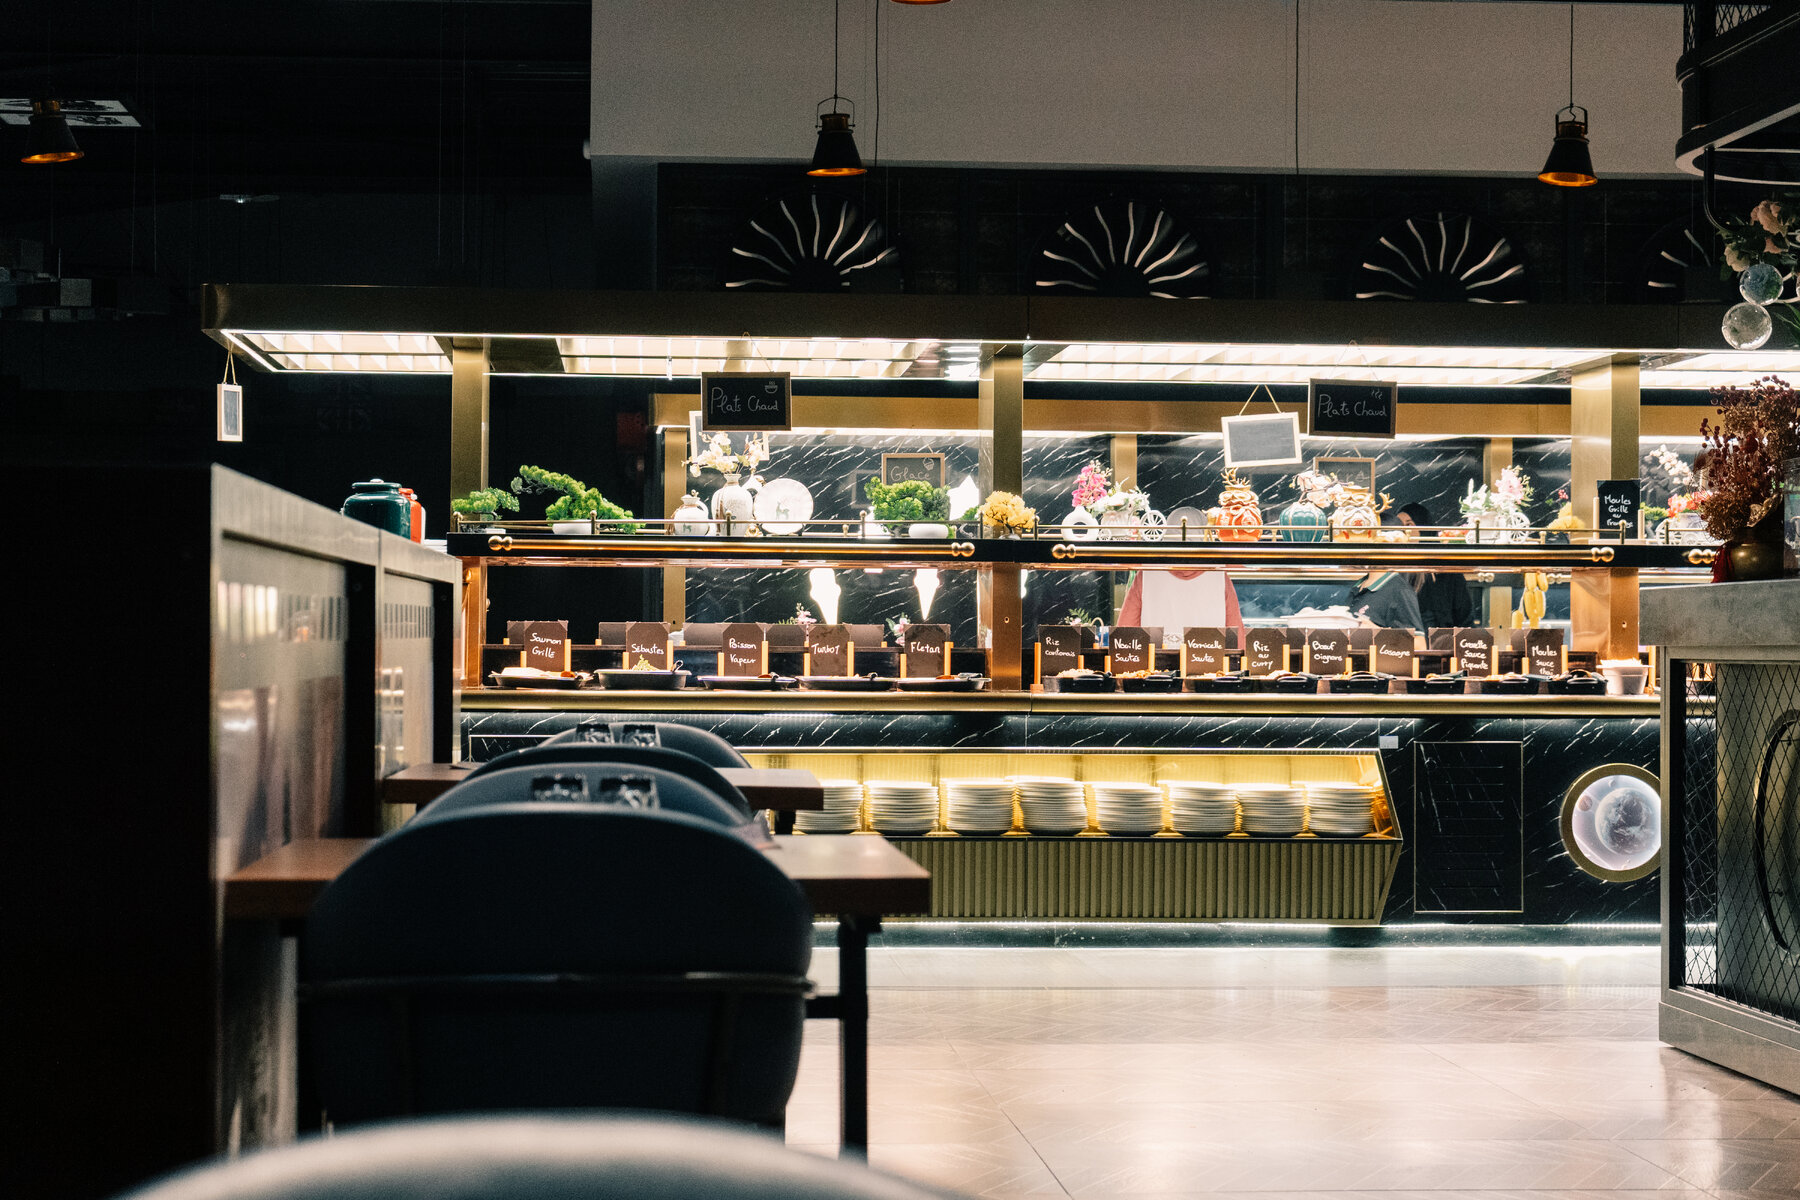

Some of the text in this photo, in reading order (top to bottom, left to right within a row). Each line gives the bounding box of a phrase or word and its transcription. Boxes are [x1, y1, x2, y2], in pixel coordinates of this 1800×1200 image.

[711, 387, 779, 415] Plats Chaud
[1318, 394, 1350, 418] Plats
[890, 465, 931, 481] Glace
[530, 632, 562, 645] Saumon
[728, 637, 757, 650] Poisson
[1045, 636, 1060, 646] Riz
[1253, 640, 1270, 652] Riz
